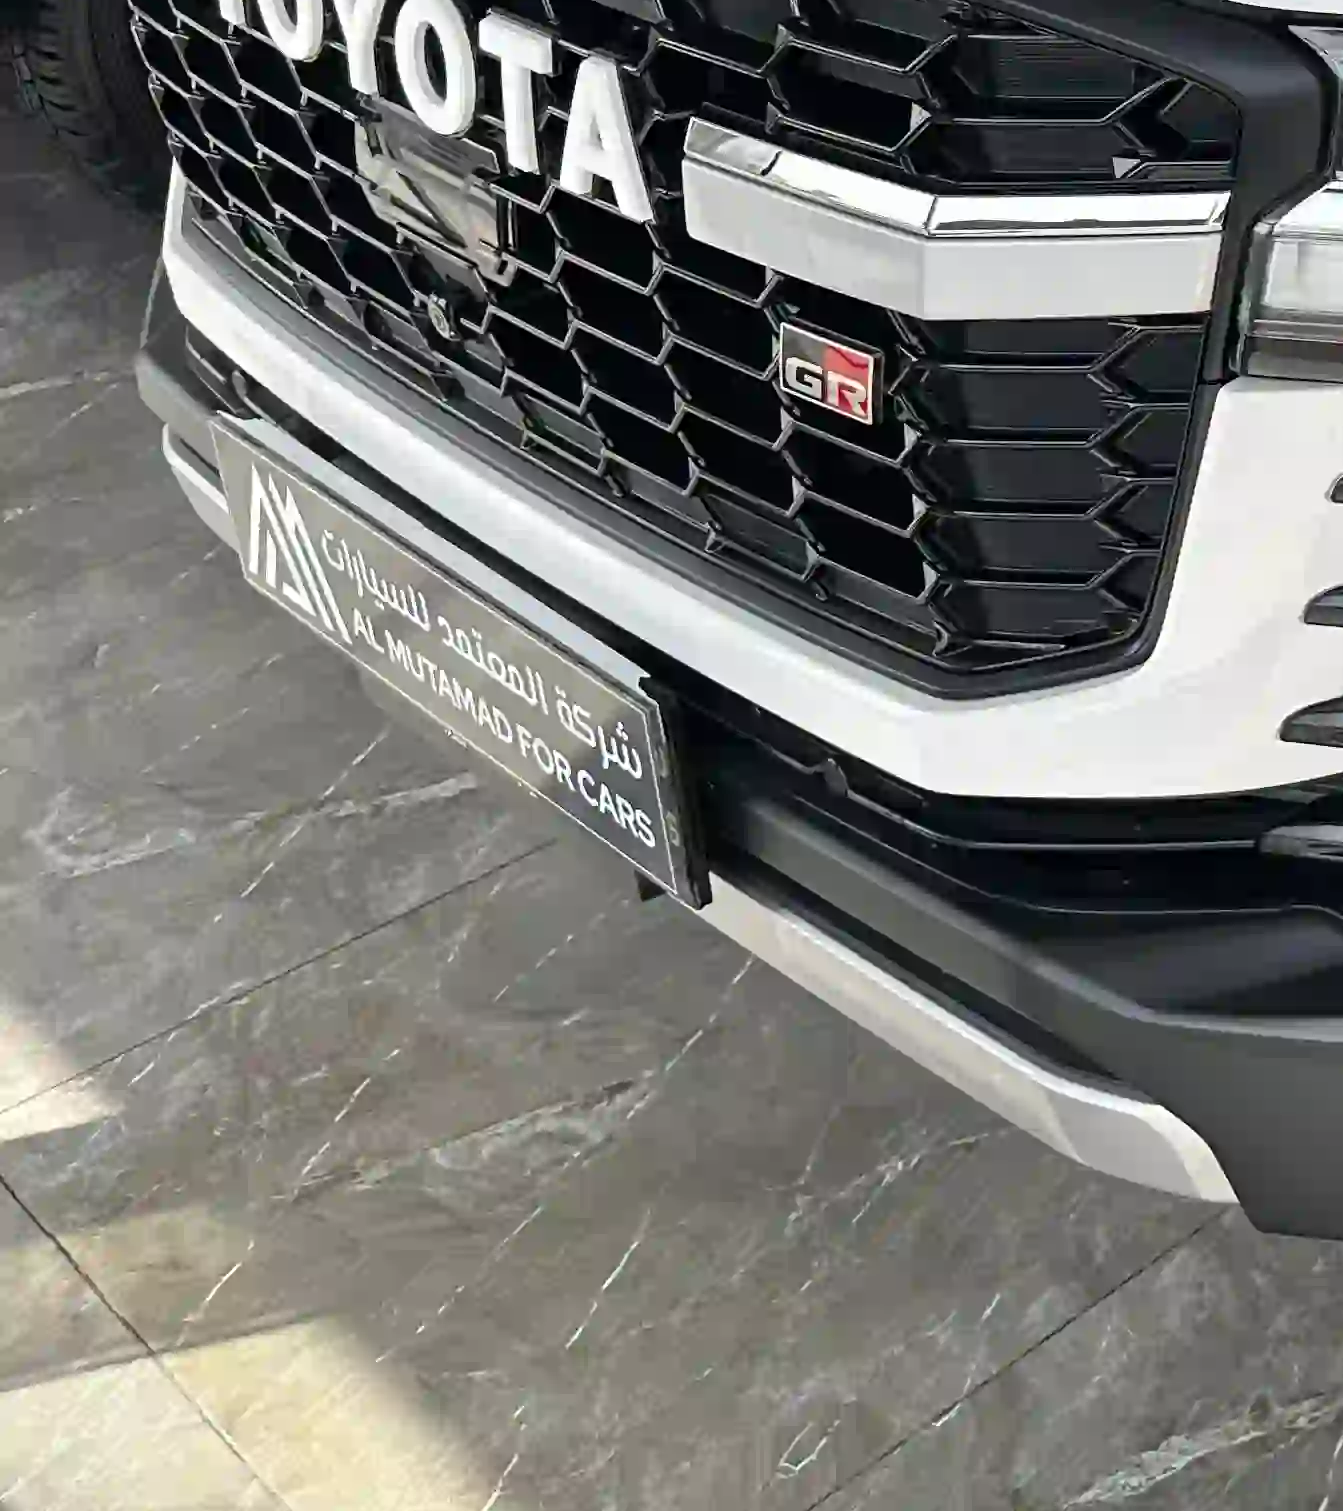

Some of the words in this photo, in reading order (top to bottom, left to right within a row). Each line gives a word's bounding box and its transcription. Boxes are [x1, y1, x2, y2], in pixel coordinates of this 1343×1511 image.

[784, 356, 868, 418] GR
[321, 528, 432, 633] للسيارات
[437, 614, 550, 716] المعتمد
[353, 607, 385, 655] AL
[384, 628, 513, 744] MUTAMAD
[515, 722, 577, 792] FOR
[577, 769, 657, 849] CARS
[553, 685, 643, 780] شركة
